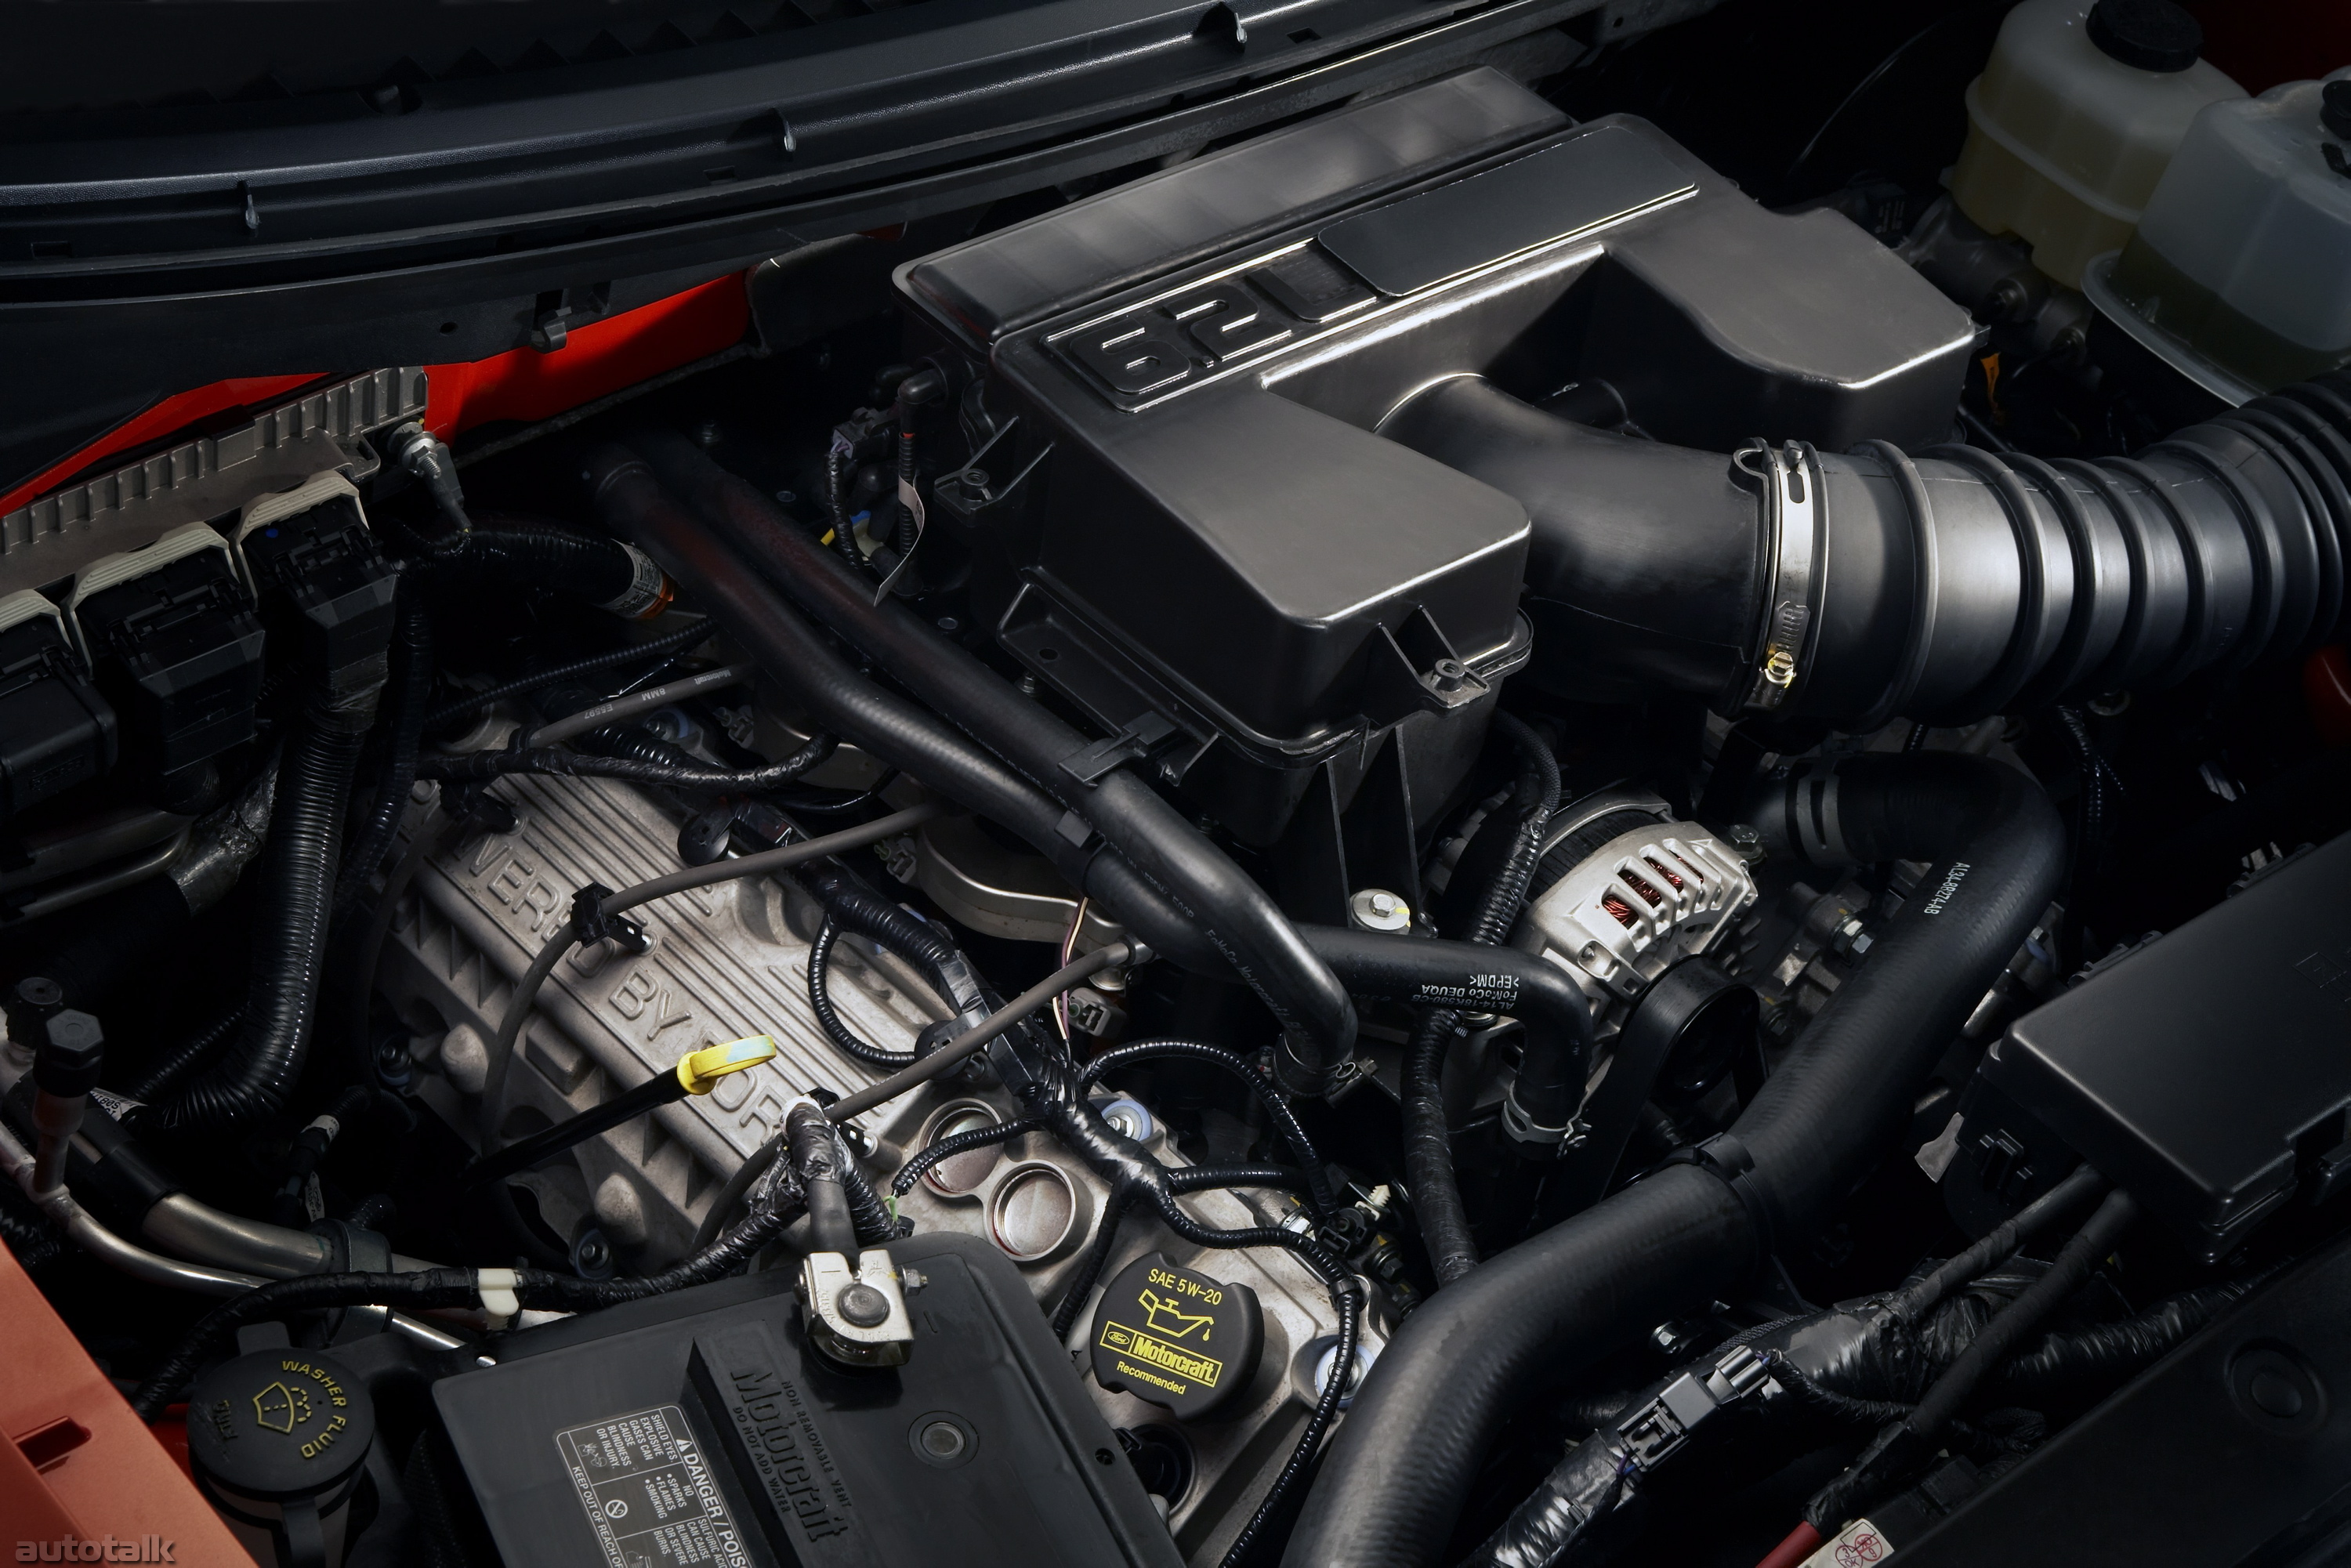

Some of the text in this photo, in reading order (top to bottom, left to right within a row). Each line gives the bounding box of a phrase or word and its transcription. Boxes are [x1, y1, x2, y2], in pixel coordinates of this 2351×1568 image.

[1069, 266, 1378, 397] 6.2L
[641, 687, 666, 701] 8MM
[694, 669, 731, 686] Motorcraft
[609, 964, 692, 1041] BY
[1422, 984, 1518, 1001] FoMoCo DEUQA
[1148, 1268, 1223, 1305] SAE 5W-20
[1116, 1360, 1186, 1395] Recommended
[1133, 1336, 1214, 1382] Motorcraft
[281, 1360, 347, 1459] WASHER FLUID
[596, 1428, 621, 1469] OR INJURY.
[607, 1425, 632, 1466] BLINDNESS
[618, 1422, 636, 1447] CAUSE
[629, 1419, 654, 1461] GASES CAN
[639, 1417, 665, 1457] EXPLOSIVE
[650, 1414, 678, 1463] SHIELD EYES.
[781, 1380, 853, 1508] NON REMOVABLE VENT
[730, 1371, 849, 1543] Motorcraft
[733, 1407, 792, 1513] DO NOT ADD WATER
[572, 1465, 589, 1490] KEEP
[656, 1480, 676, 1511] FLAMES
[667, 1478, 687, 1508] SPARKS
[683, 1454, 723, 1519] DANGER
[683, 1484, 694, 1497] NO
[583, 1491, 598, 1509] OUT
[592, 1511, 604, 1523] OF
[645, 1483, 668, 1519] SMOKING
[597, 1524, 618, 1556] REACH
[654, 1530, 672, 1557] BURNS.
[665, 1527, 689, 1566] OR SEVERE
[676, 1524, 700, 1564] BLINDNESS
[686, 1521, 711, 1560] CAN CAUSE
[697, 1519, 720, 1553] SULFURIC
[1844, 1558, 1860, 1568] OK
